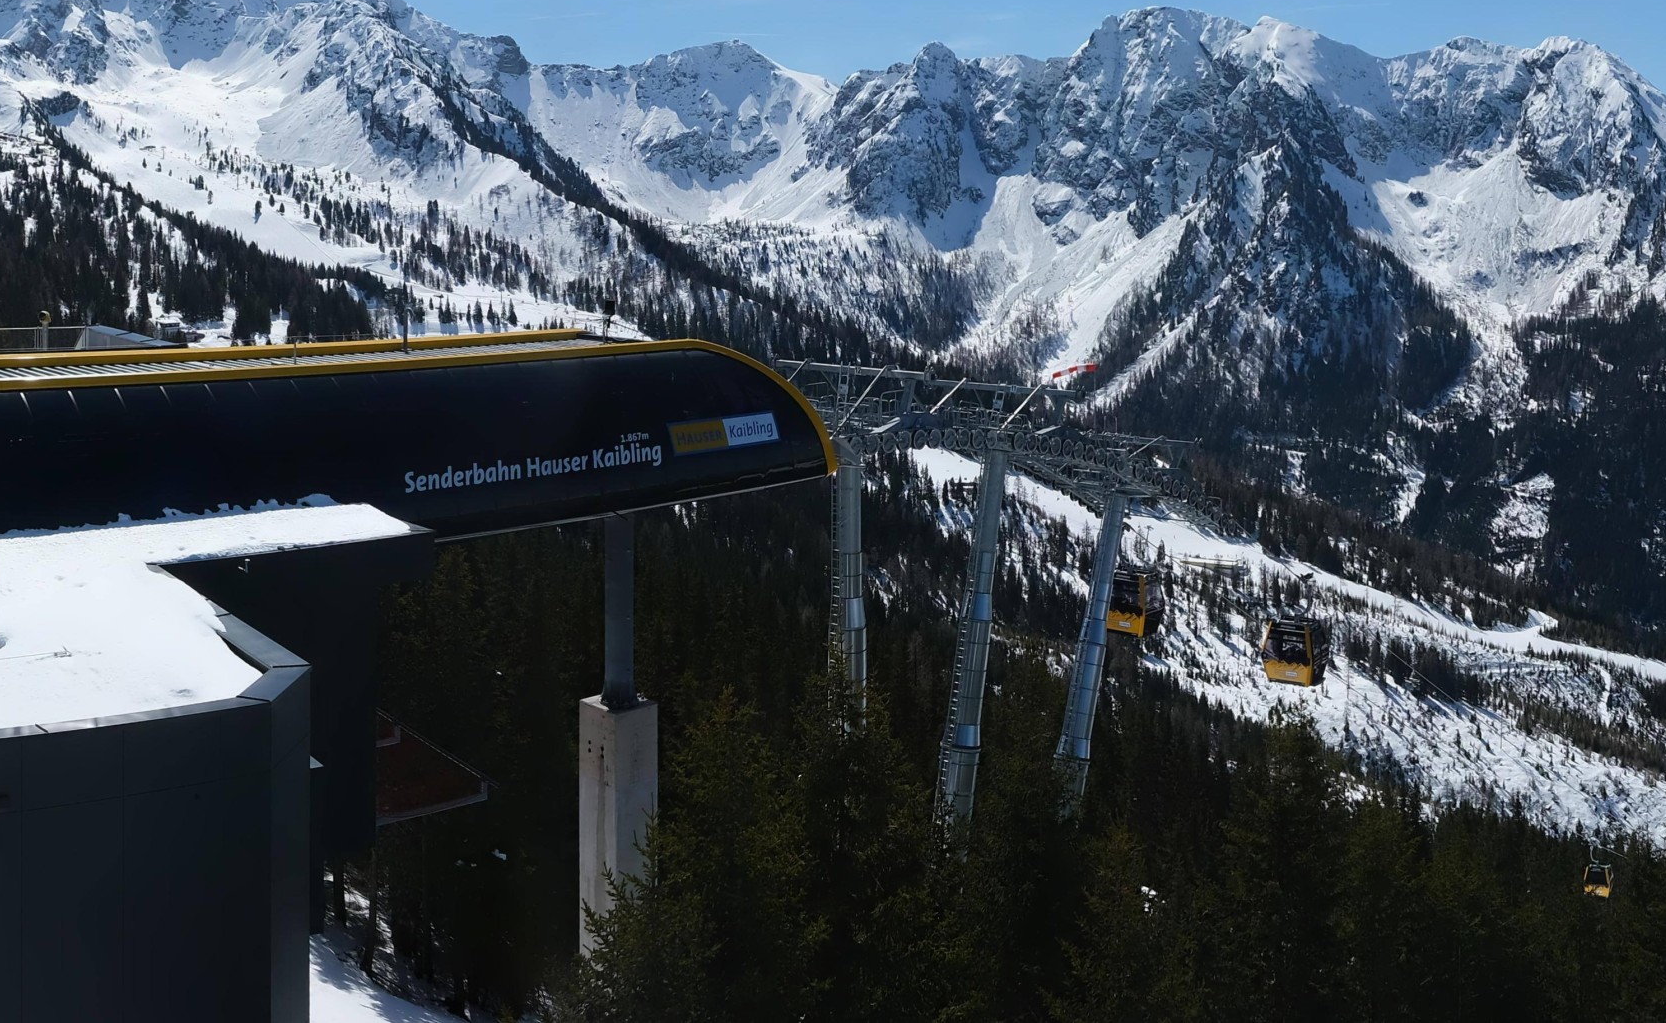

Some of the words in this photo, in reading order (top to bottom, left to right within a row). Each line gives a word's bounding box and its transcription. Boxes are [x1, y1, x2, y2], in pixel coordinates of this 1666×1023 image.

[620, 432, 650, 443] 1.867m
[675, 428, 723, 447] HAUSER
[729, 420, 774, 440] Kaibling
[404, 459, 522, 494] Senderbahn
[526, 455, 589, 478] Hauser
[592, 443, 662, 469] Kaibling
